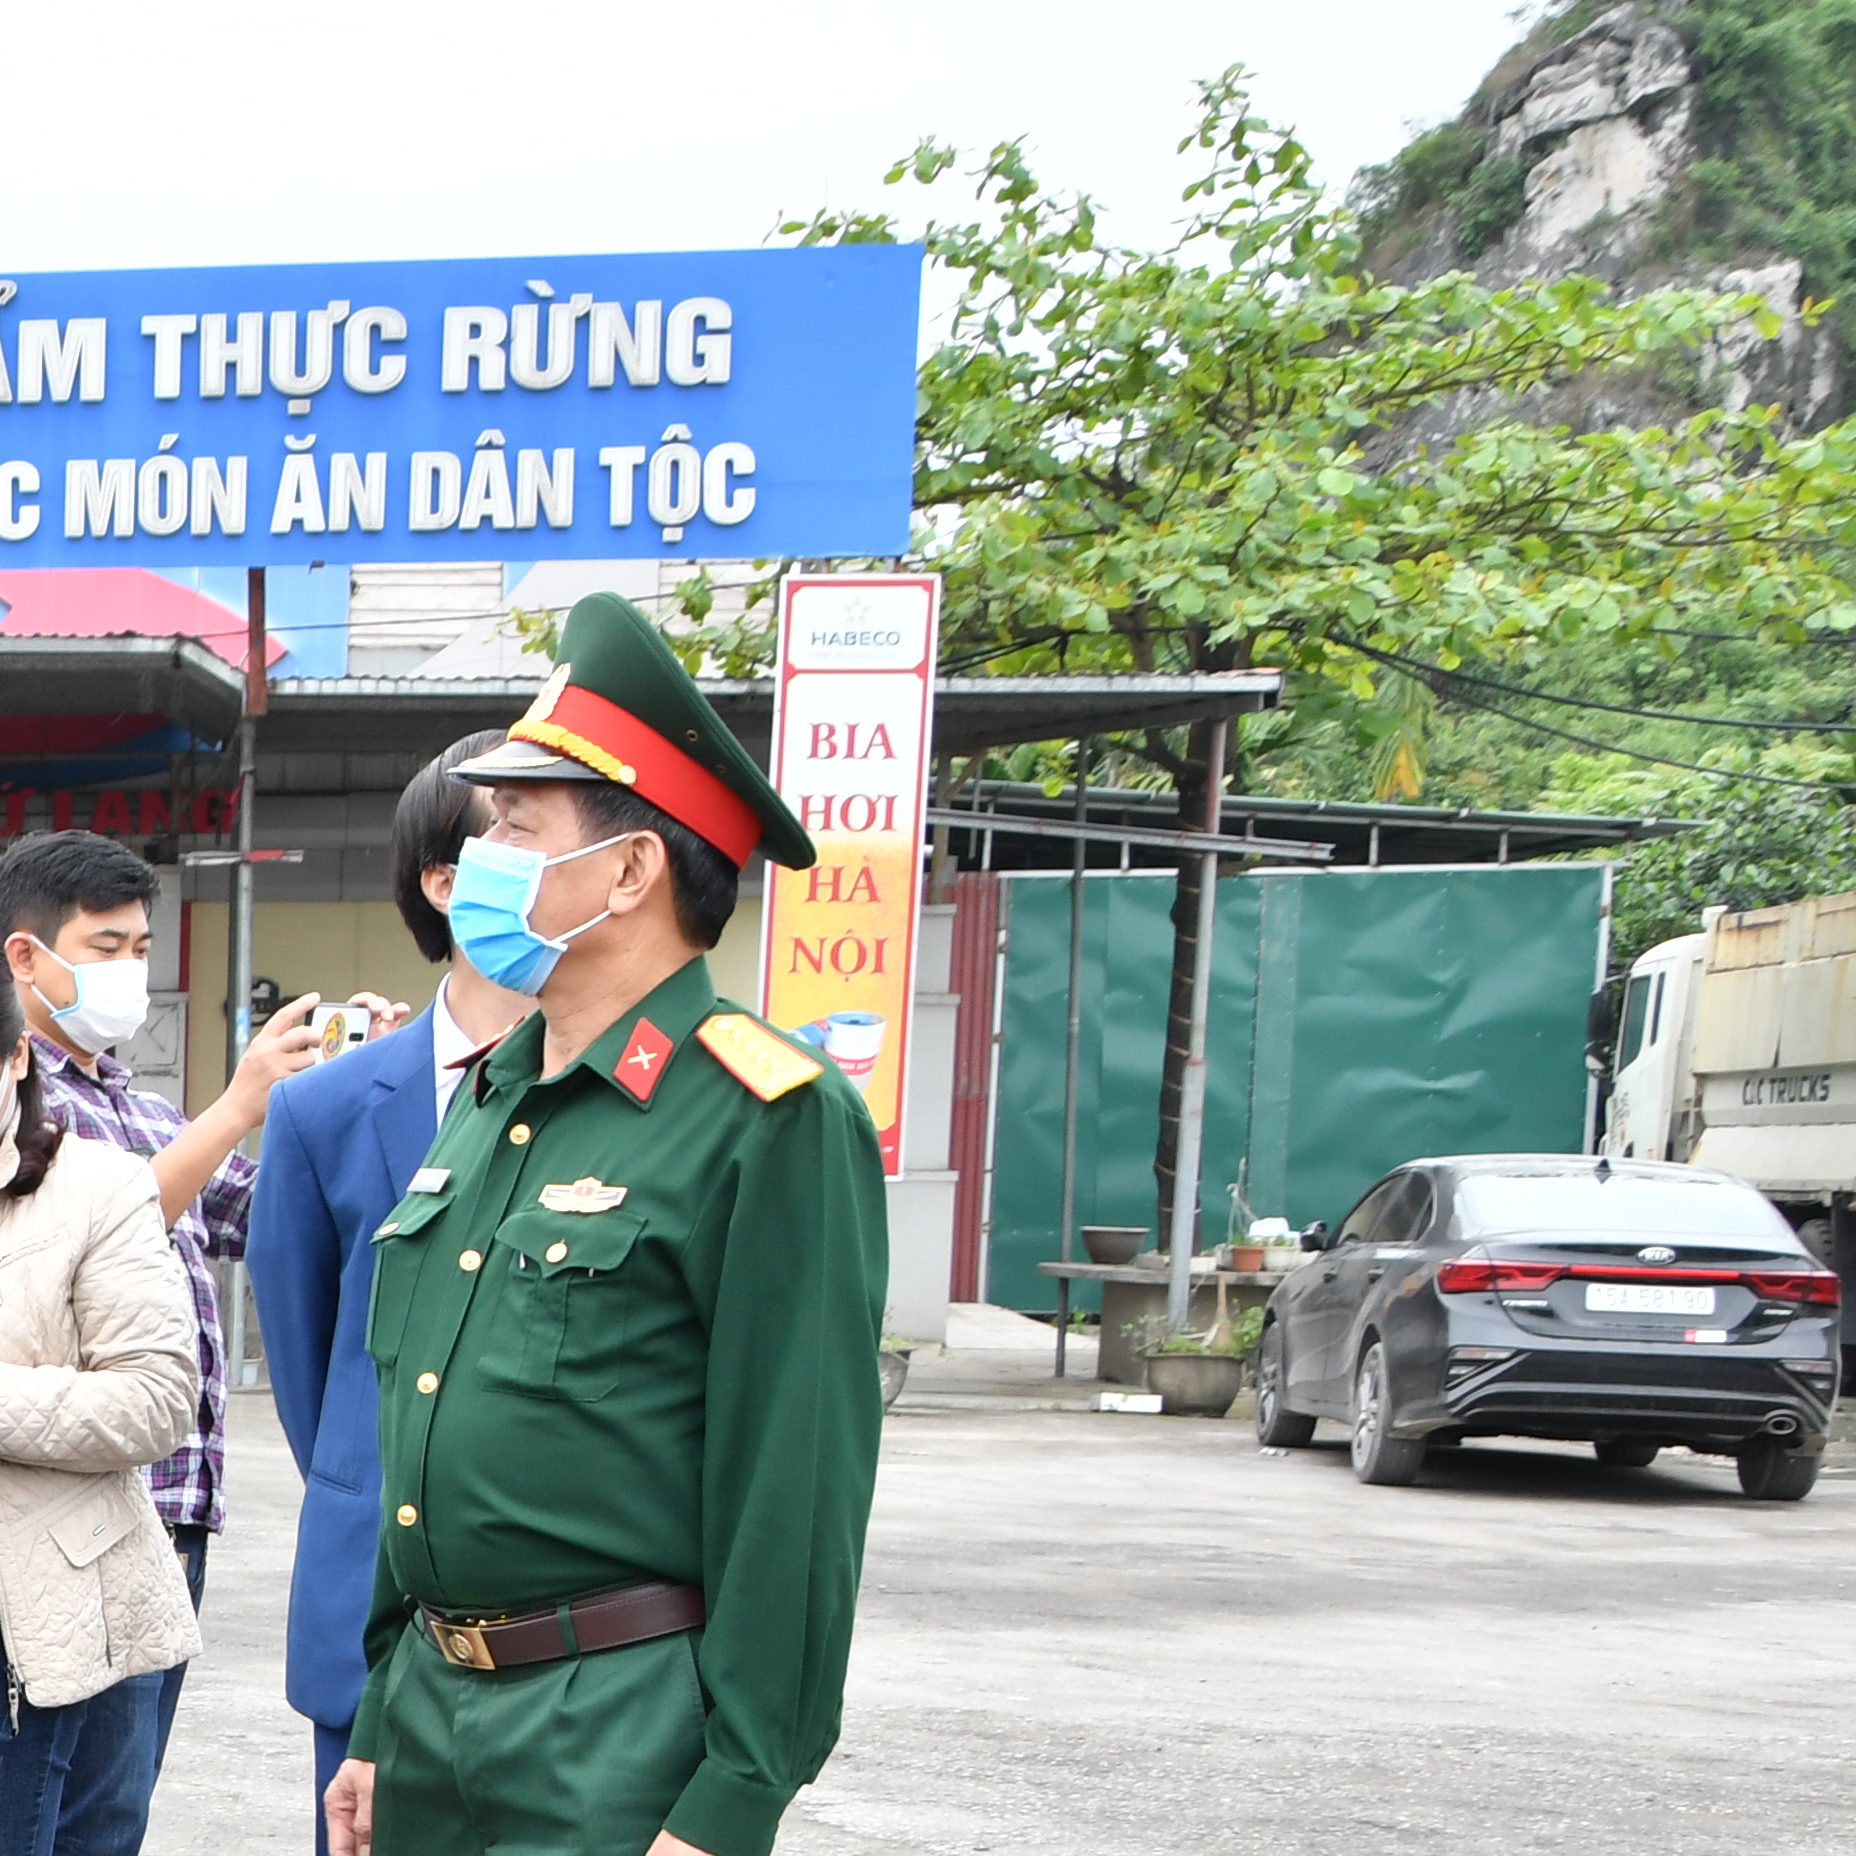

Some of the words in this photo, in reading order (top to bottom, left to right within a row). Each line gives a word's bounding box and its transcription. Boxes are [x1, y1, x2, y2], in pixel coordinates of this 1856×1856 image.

[141, 300, 407, 415] THỰC
[442, 280, 732, 390] RỪNG
[65, 434, 247, 536] MÓN
[271, 429, 386, 532] ĂN
[409, 429, 574, 529] DÂN
[600, 424, 755, 541] TỘC
[811, 630, 901, 647] HABECO
[806, 723, 897, 760] BIA
[799, 793, 899, 833] HƠI
[804, 852, 881, 903] HÀ
[789, 928, 888, 982] NỘI
[1768, 1073, 1832, 1105] TRUCKS
